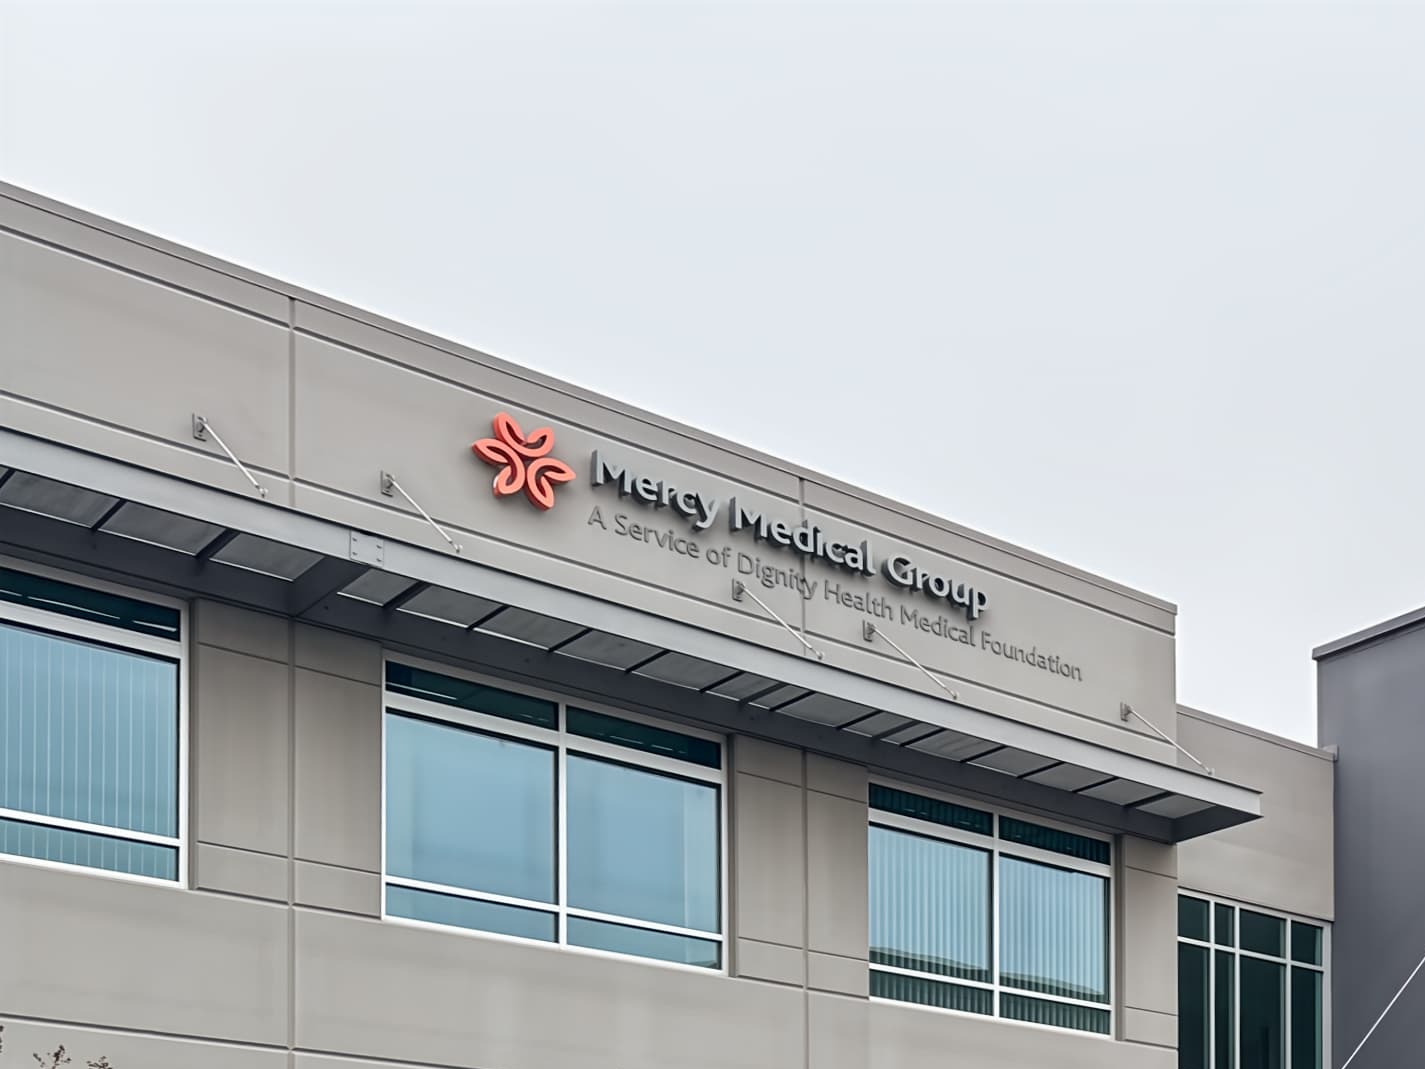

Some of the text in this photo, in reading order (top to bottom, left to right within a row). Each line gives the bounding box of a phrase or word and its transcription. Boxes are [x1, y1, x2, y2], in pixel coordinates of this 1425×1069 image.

[588, 506, 1083, 681] A Service of Dignity Health Medical Foundation
[591, 450, 989, 620] Mercy Medical Group
